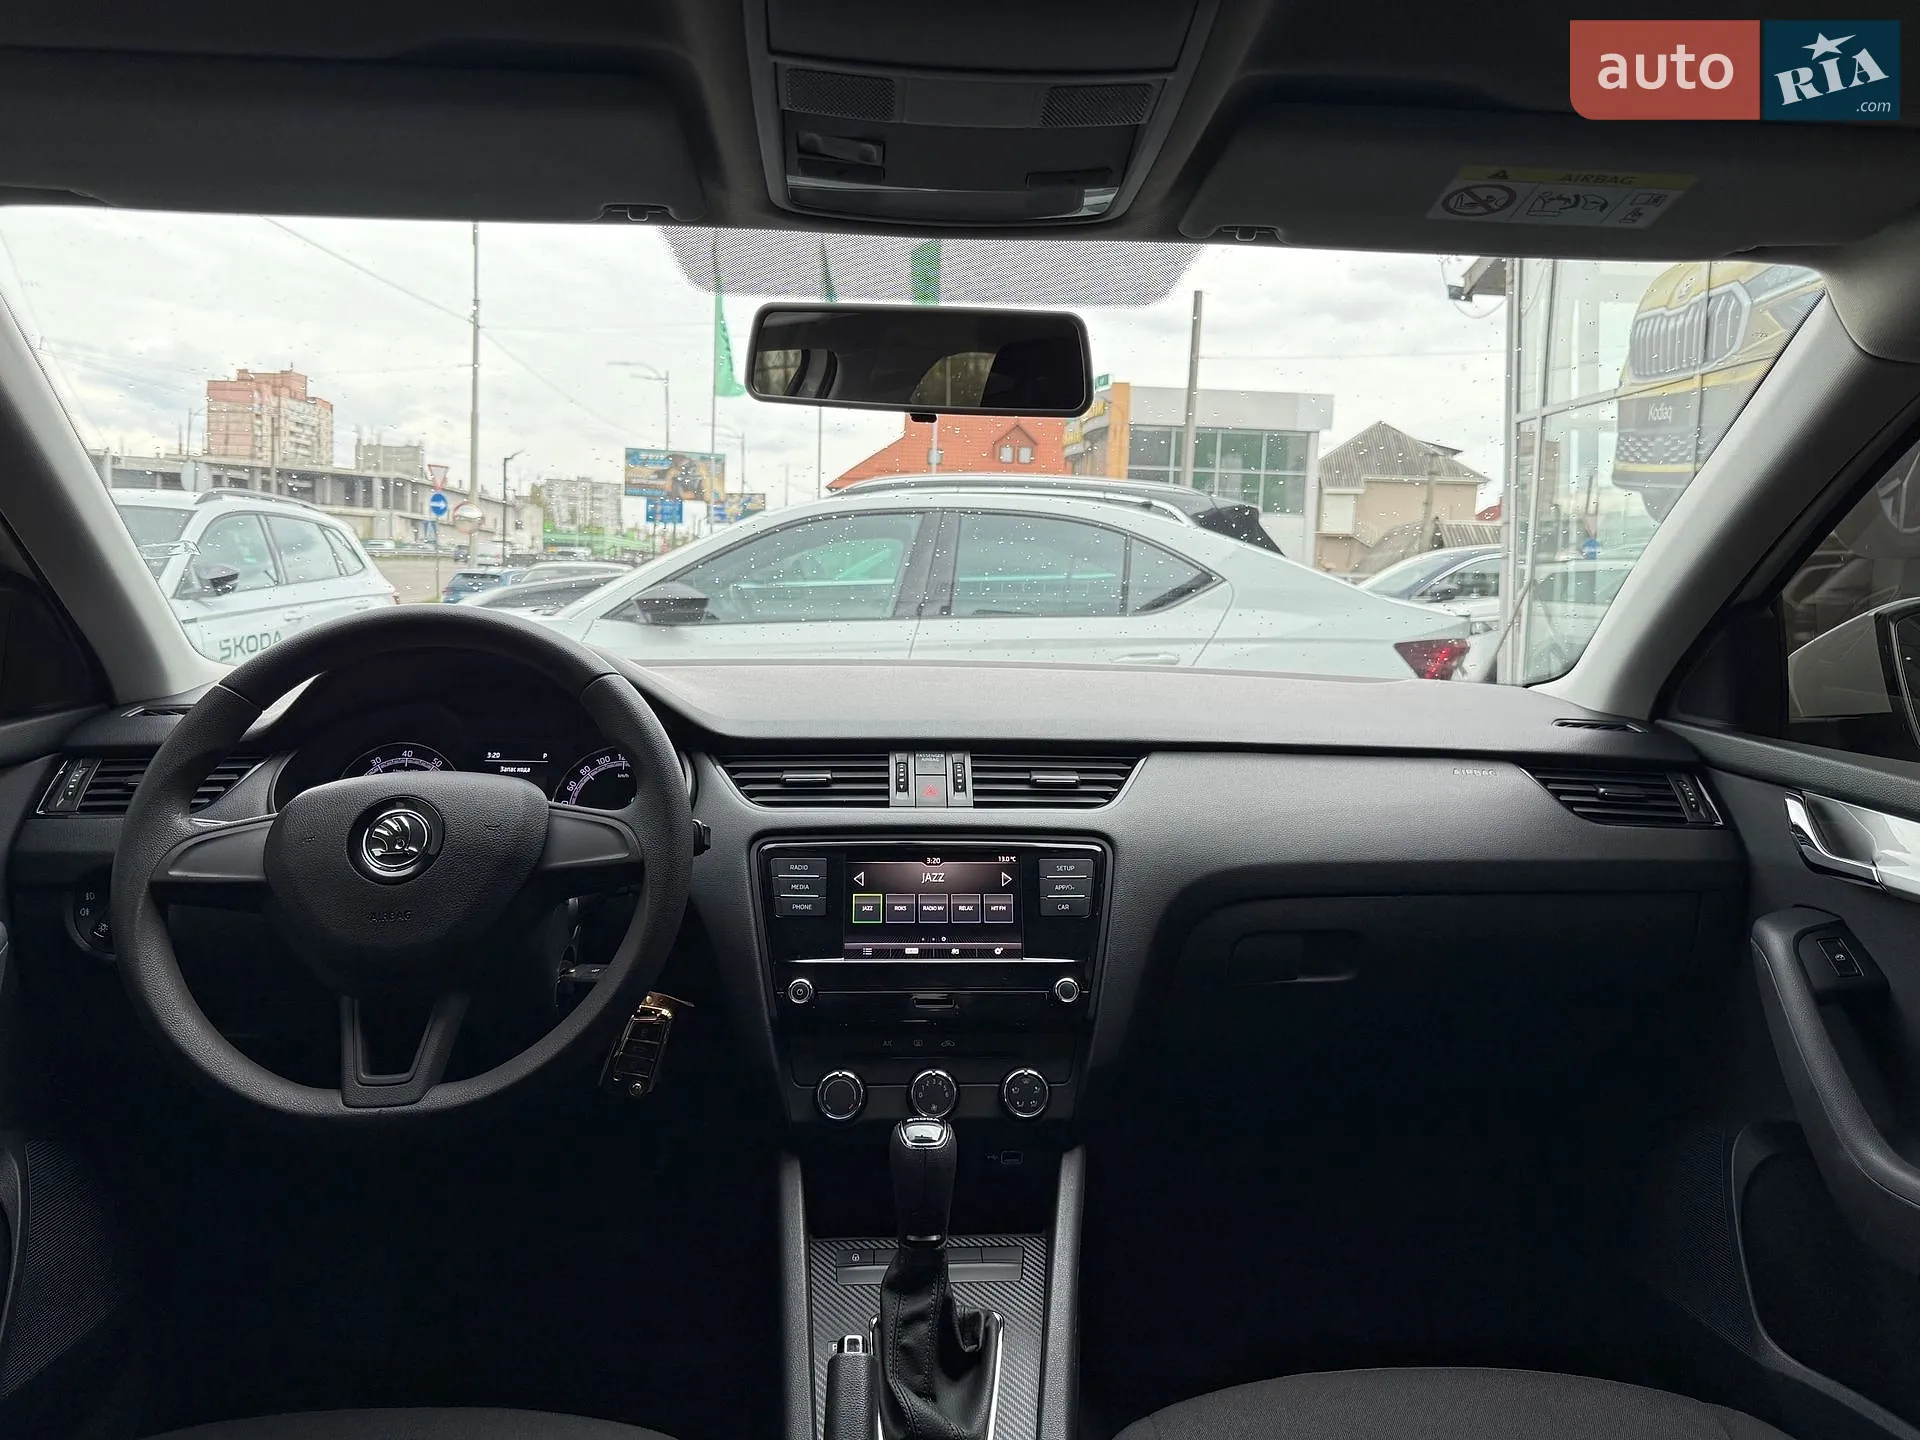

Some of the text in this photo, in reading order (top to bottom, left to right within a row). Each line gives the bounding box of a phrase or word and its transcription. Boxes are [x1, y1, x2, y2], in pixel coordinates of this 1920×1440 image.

[1559, 173, 1637, 186] AIRBAG
[401, 750, 413, 758] 40
[486, 751, 548, 760] 3:20 P
[370, 756, 382, 767] 30
[431, 757, 443, 768] 50
[595, 755, 611, 766] 100
[579, 765, 591, 776] 80
[566, 780, 577, 792] 60
[921, 872, 945, 883] JAZZ
[792, 903, 812, 911] PHONE
[1057, 903, 1070, 911] CAR
